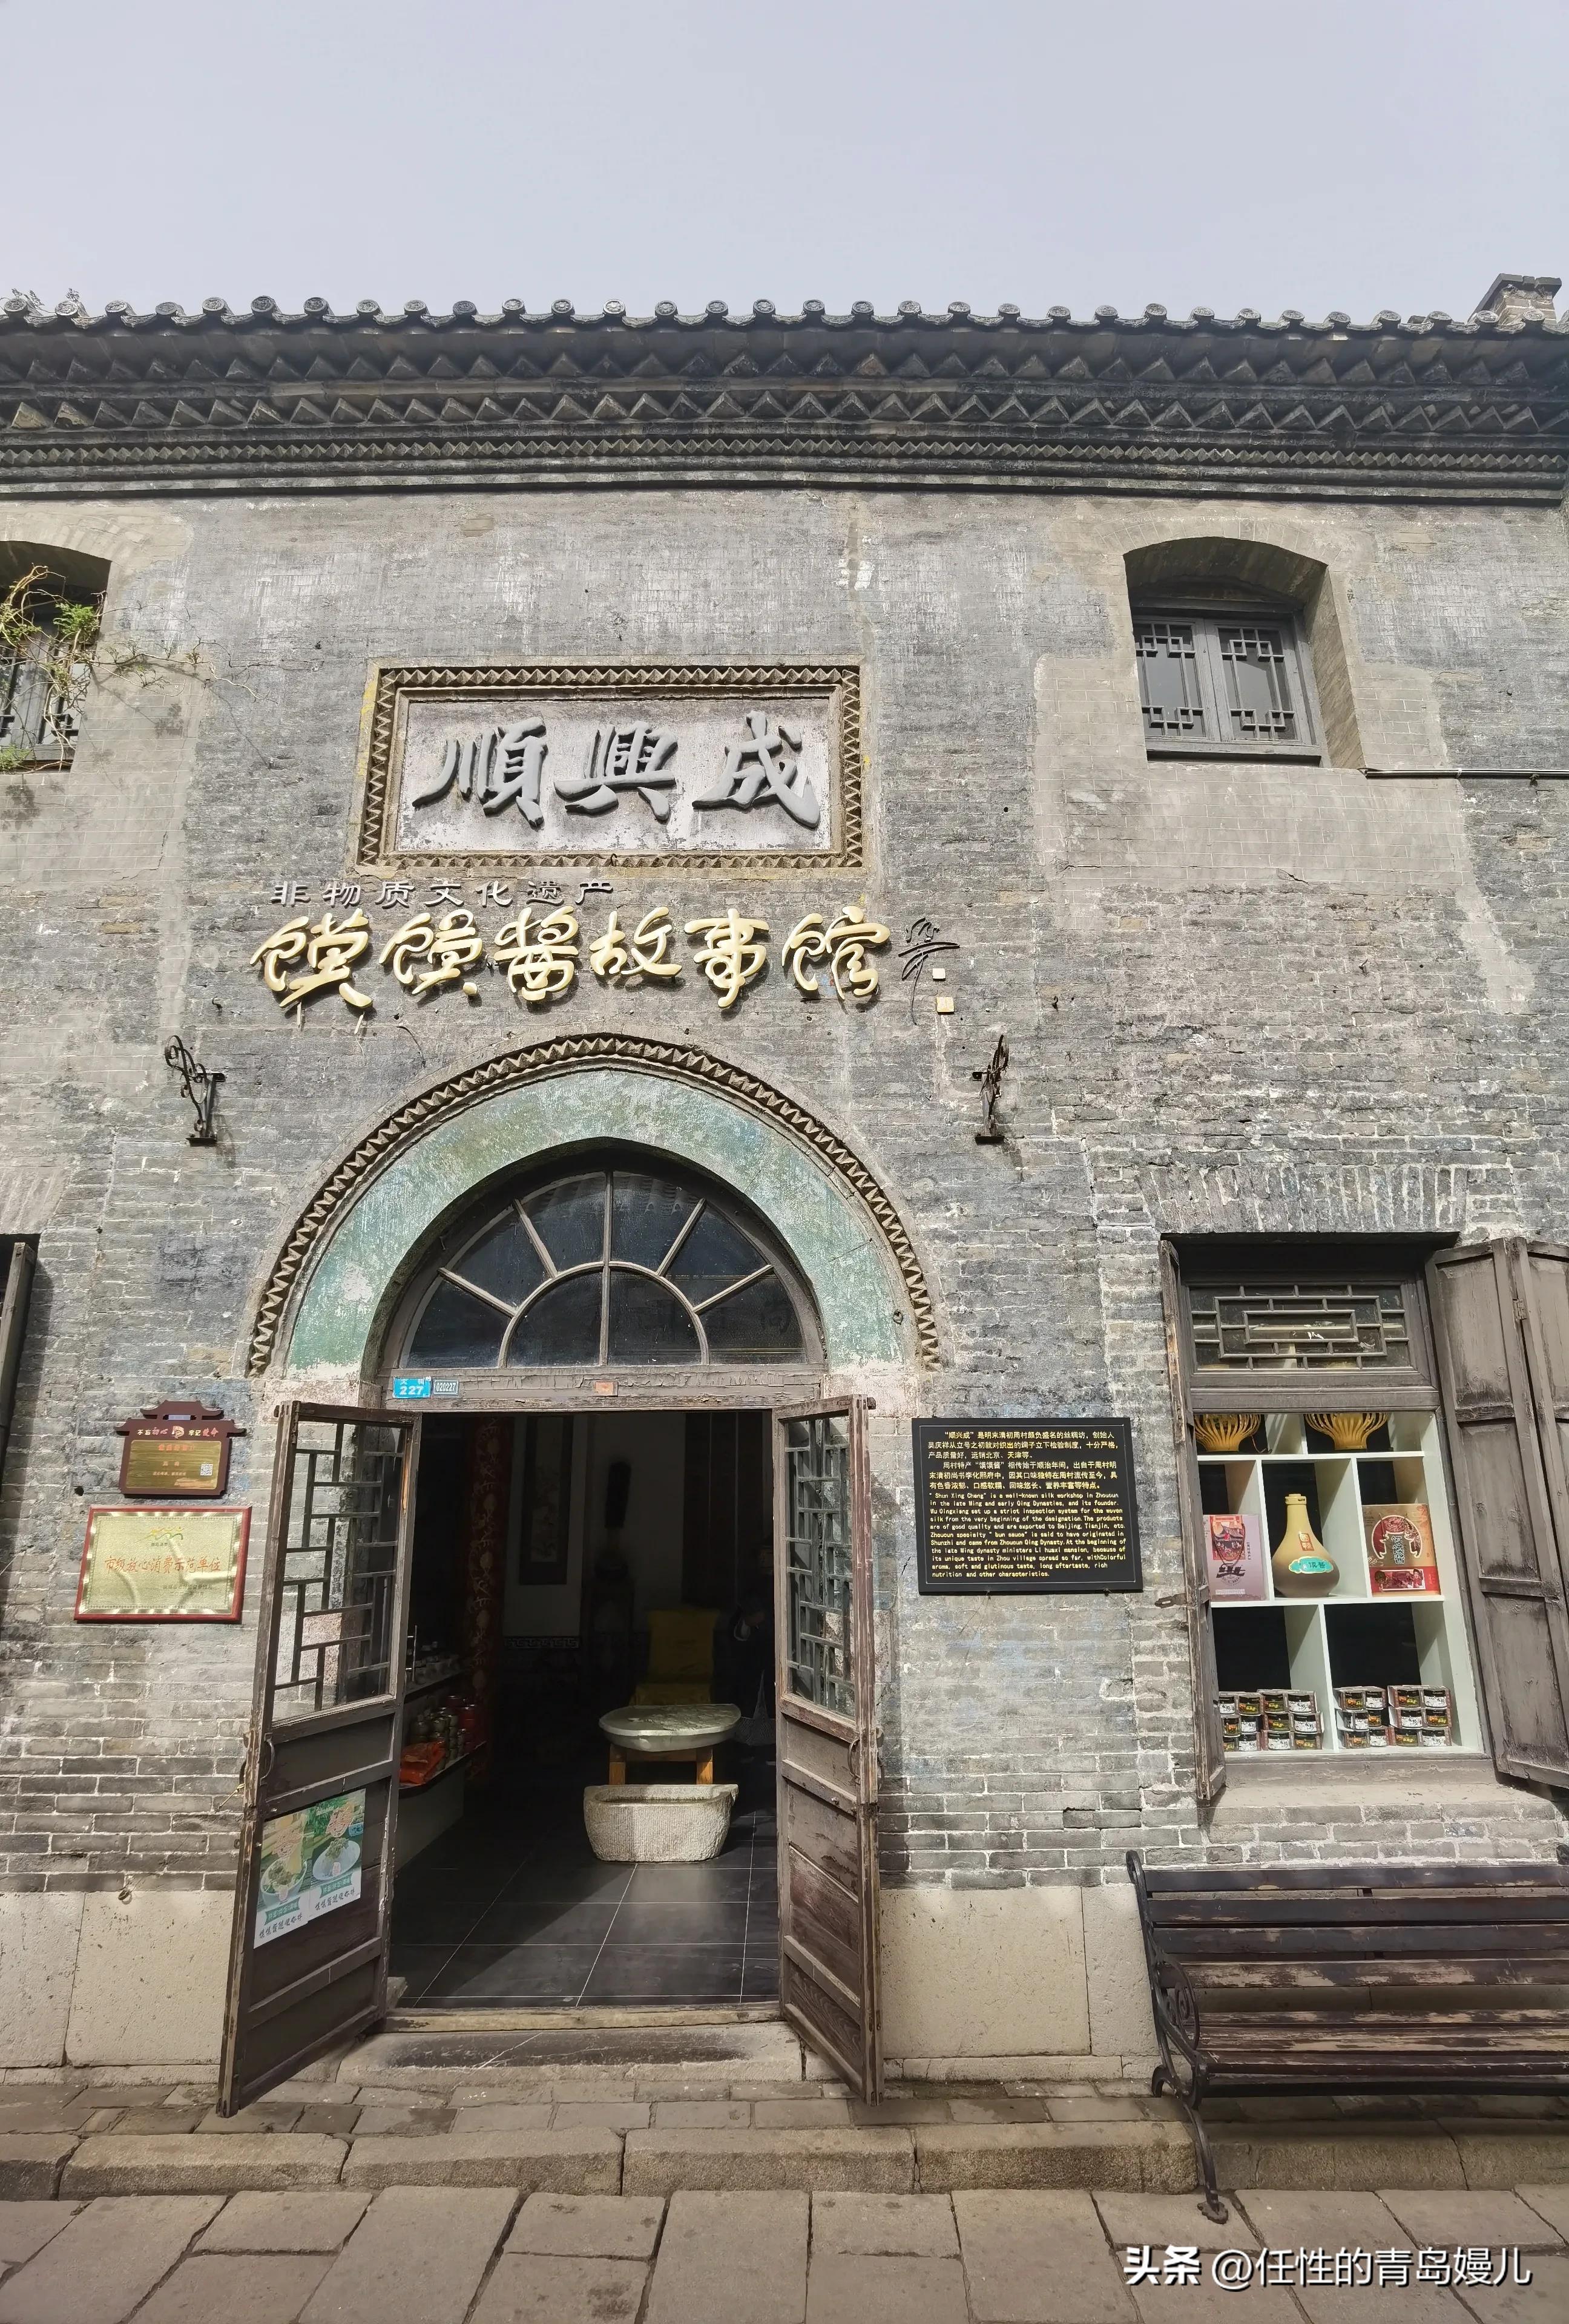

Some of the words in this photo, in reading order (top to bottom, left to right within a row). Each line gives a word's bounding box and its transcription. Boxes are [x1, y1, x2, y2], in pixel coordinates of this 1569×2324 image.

[271, 879, 614, 908] 非物质文化遗产
[399, 1385, 424, 1395] 227
[436, 1382, 456, 1392] 020227
[137, 1426, 169, 1436] 不忘初心
[188, 1427, 219, 1437] 牢记使命
[104, 1555, 221, 1574] 市级放心消费示范单位
